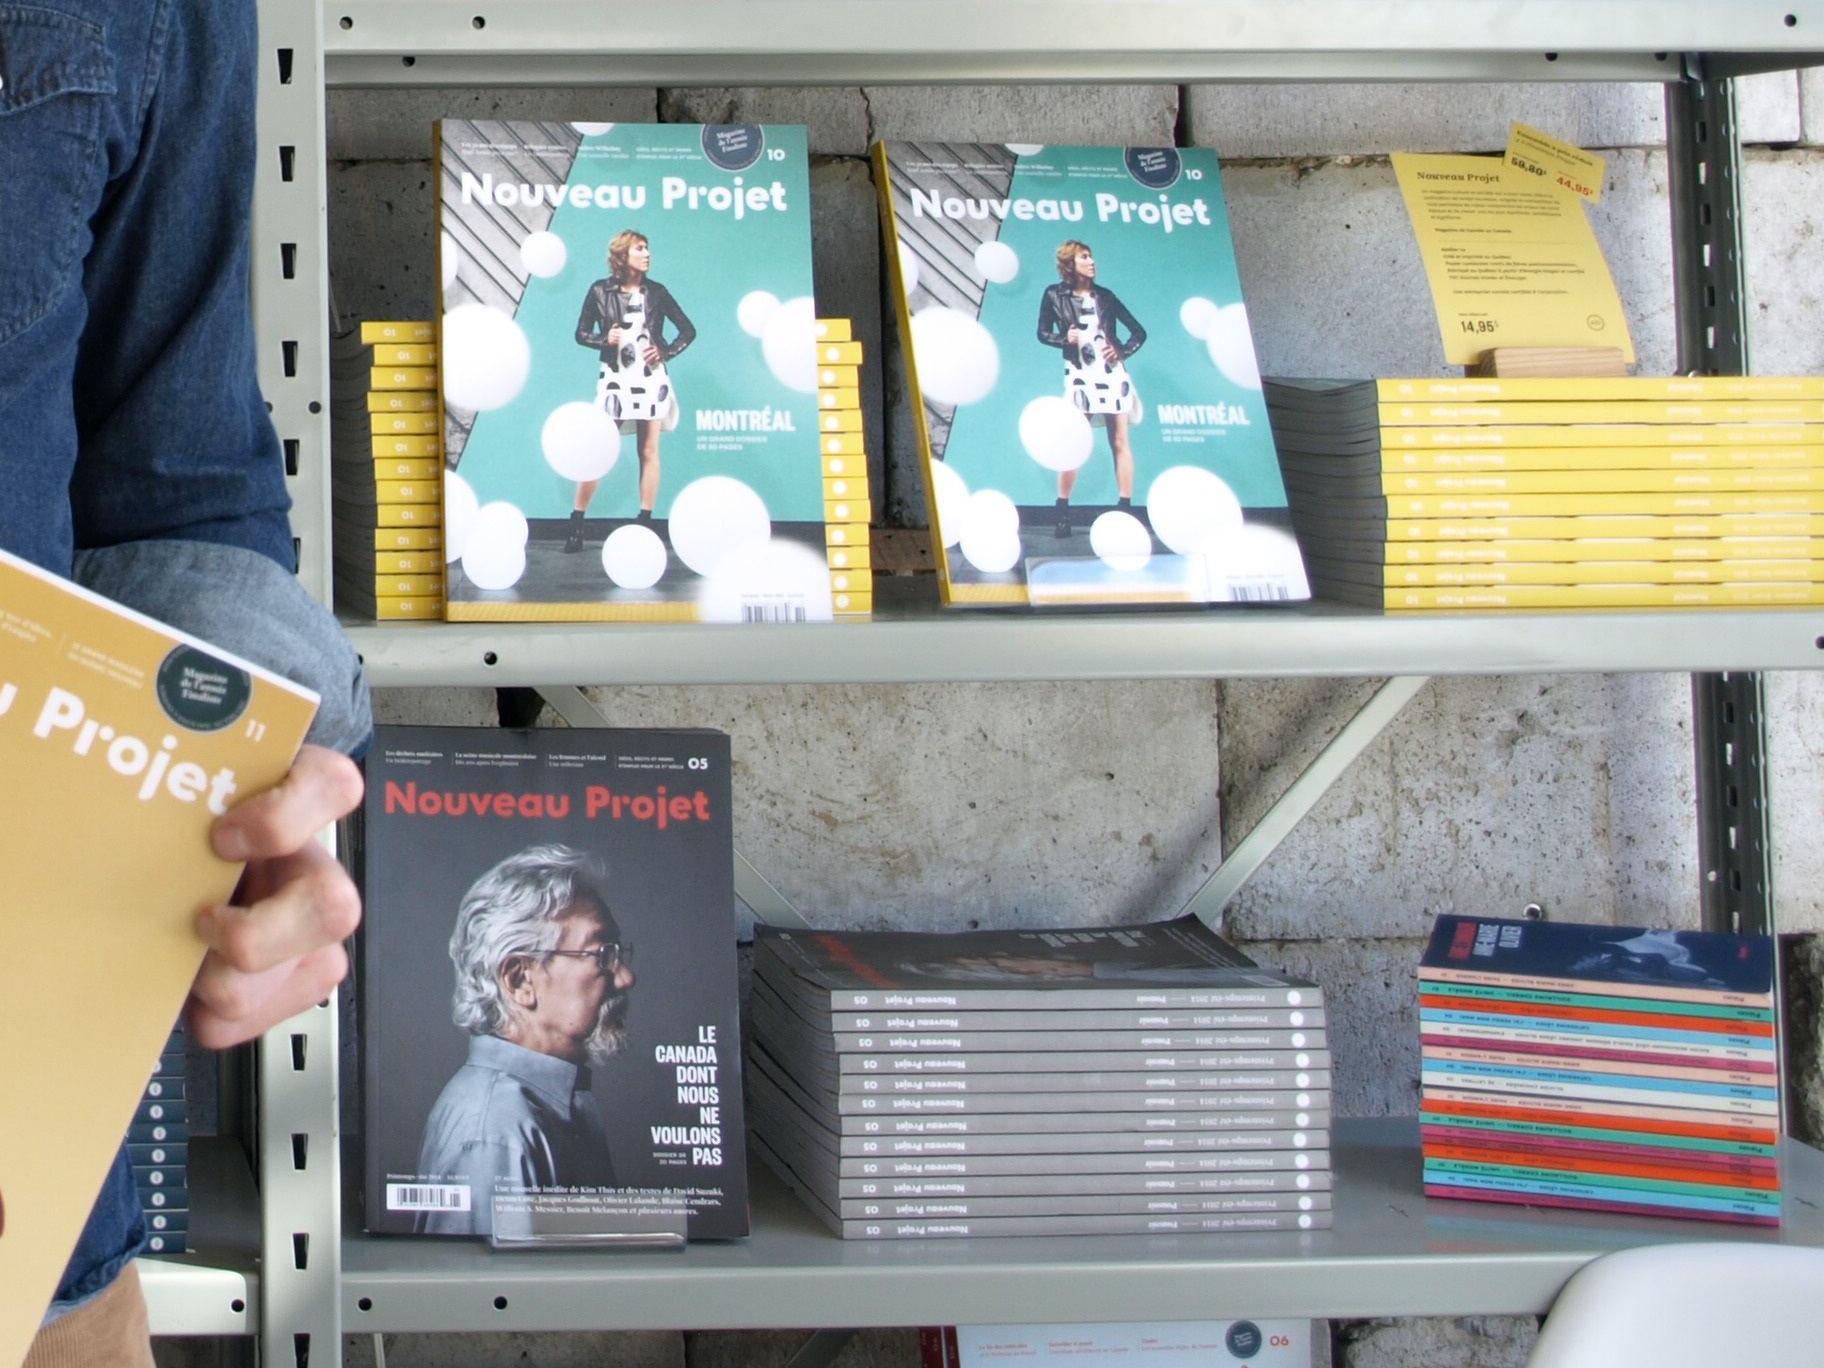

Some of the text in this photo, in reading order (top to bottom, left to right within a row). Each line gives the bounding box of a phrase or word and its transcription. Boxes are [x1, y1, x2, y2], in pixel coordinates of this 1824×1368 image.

[766, 148, 786, 161] 10
[1185, 168, 1203, 181] 10
[1416, 171, 1500, 184] Nouveau Projet
[460, 171, 788, 220] Nouveau Projet
[910, 188, 1212, 234] Nouveau Projet
[695, 404, 796, 432] MONTRÉAL
[1157, 400, 1252, 426] MONTRÉAL
[183, 666, 229, 684] Magazine
[182, 689, 222, 705] Finaliste
[245, 718, 266, 743] 11
[32, 687, 238, 817] Projet
[686, 757, 709, 770] 05
[384, 780, 710, 830] Nouveau Projet
[698, 1025, 717, 1044] LE
[655, 1044, 718, 1064] CANADA
[676, 1065, 718, 1084] DONT
[677, 1086, 720, 1104] NOUS
[699, 1106, 721, 1125] NE
[650, 1126, 722, 1145] VOULONS
[692, 1147, 723, 1166] PAS
[1268, 1334, 1289, 1347] 06
